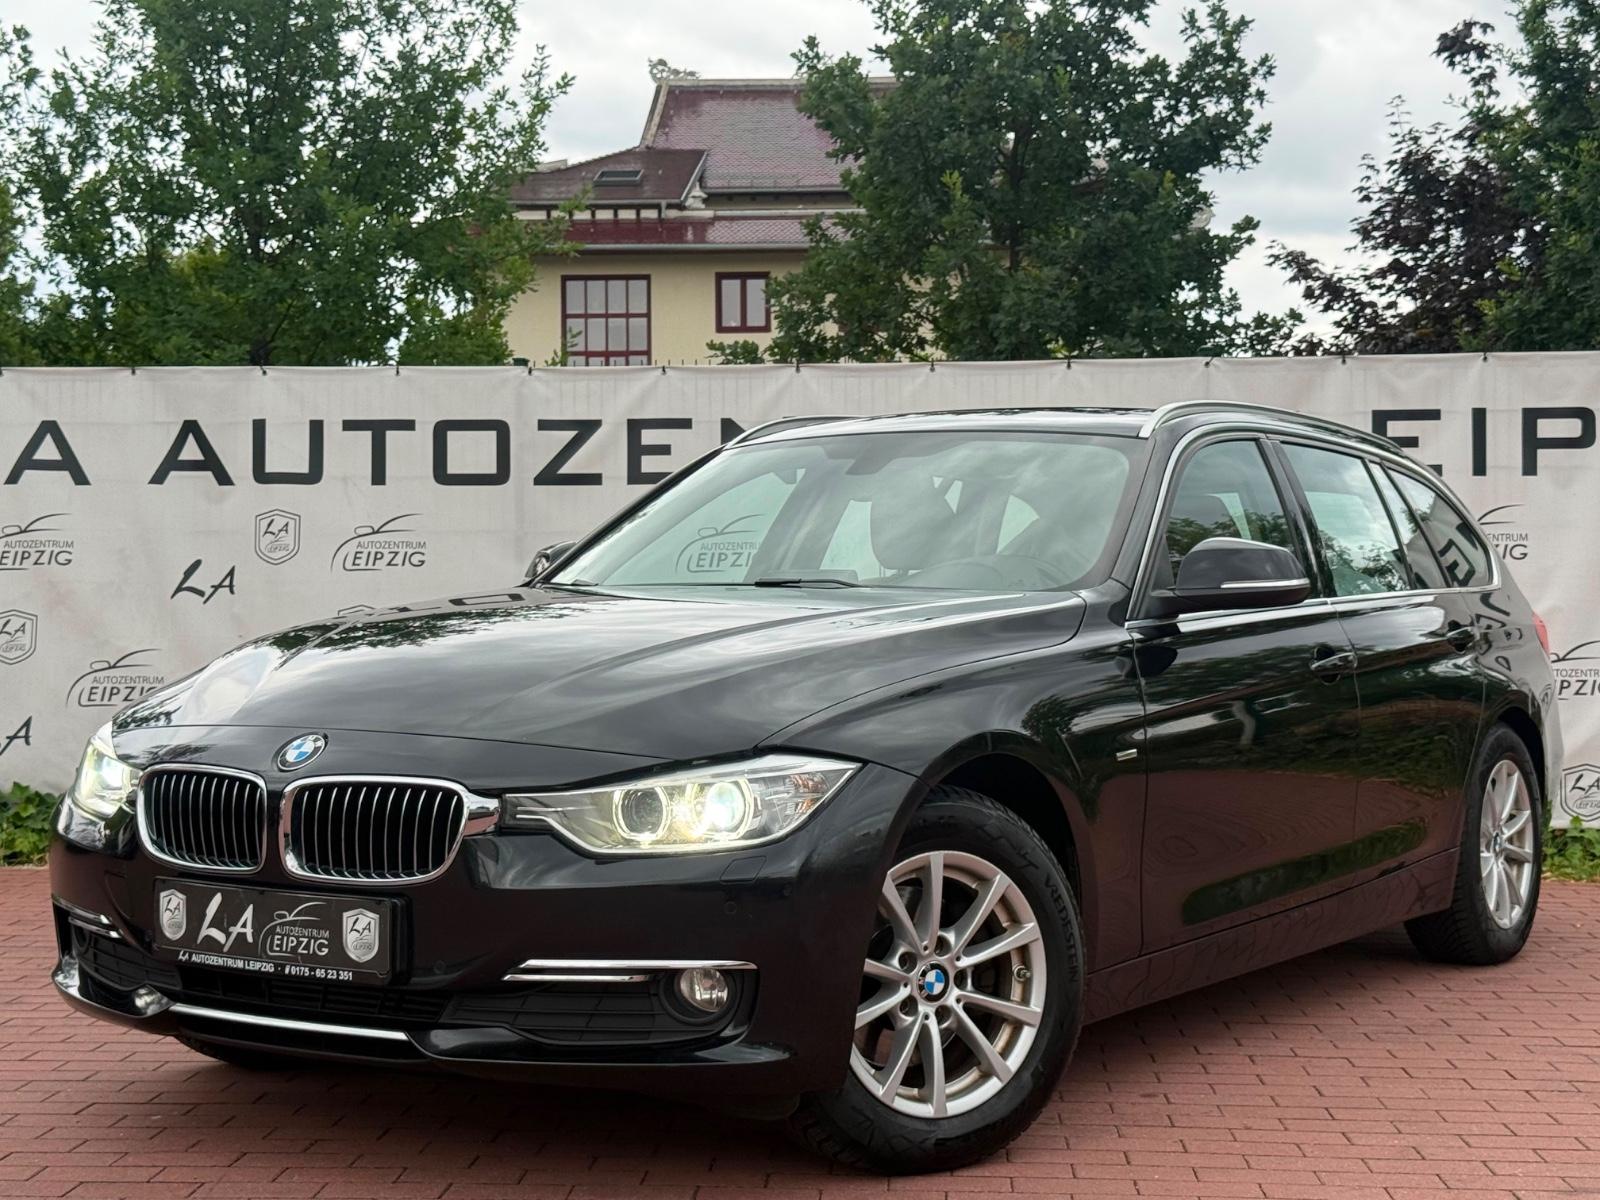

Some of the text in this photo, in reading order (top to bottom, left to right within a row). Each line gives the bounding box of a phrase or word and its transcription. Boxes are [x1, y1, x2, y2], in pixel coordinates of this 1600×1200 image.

[3, 540, 74, 548] AUTOZENTRUM
[356, 541, 426, 549] AUTOZENTRUM
[171, 559, 236, 604] LA
[92, 676, 164, 684] AUTOZENTRUM
[197, 892, 254, 953] LA
[275, 925, 330, 938] AUTOZENTRUM
[191, 953, 244, 969] AUTOZENTRUM
[245, 960, 275, 973] LEIPZIG
[291, 966, 310, 977] 0175
[315, 968, 326, 978] 65
[327, 969, 337, 979] 23
[338, 970, 353, 981] 351
